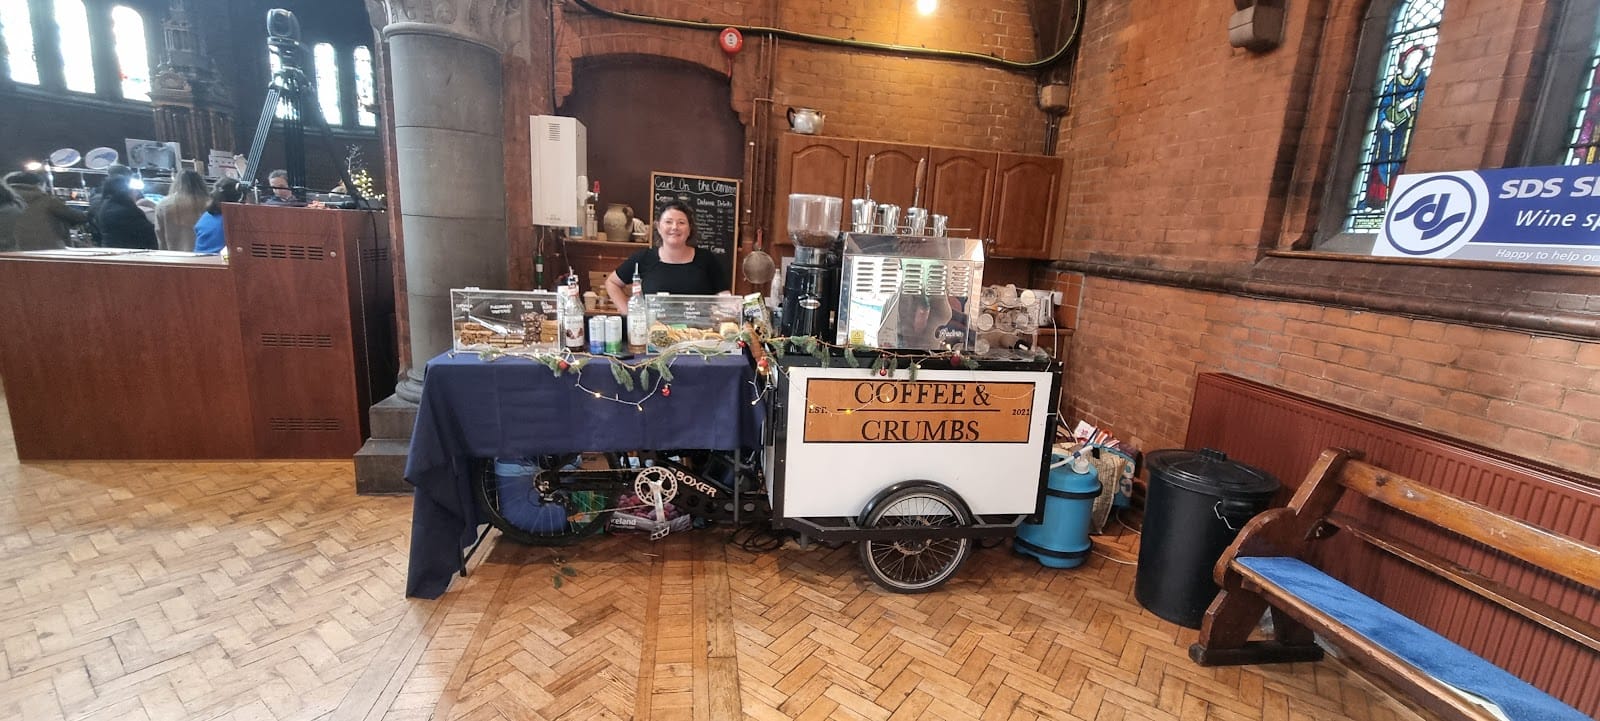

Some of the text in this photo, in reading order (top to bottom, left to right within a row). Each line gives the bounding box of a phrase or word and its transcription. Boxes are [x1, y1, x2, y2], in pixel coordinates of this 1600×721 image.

[655, 176, 675, 188] Cart
[678, 179, 690, 191] On
[1498, 177, 1564, 199] SDS
[1515, 209, 1577, 227] Wine
[1495, 248, 1534, 261] Happy
[1536, 251, 1548, 259] to
[1551, 251, 1580, 262] help
[854, 382, 992, 406] COFFEE &
[1012, 408, 1030, 416] 2021
[861, 419, 980, 441] CRUMBS
[676, 470, 717, 498] BOXER
